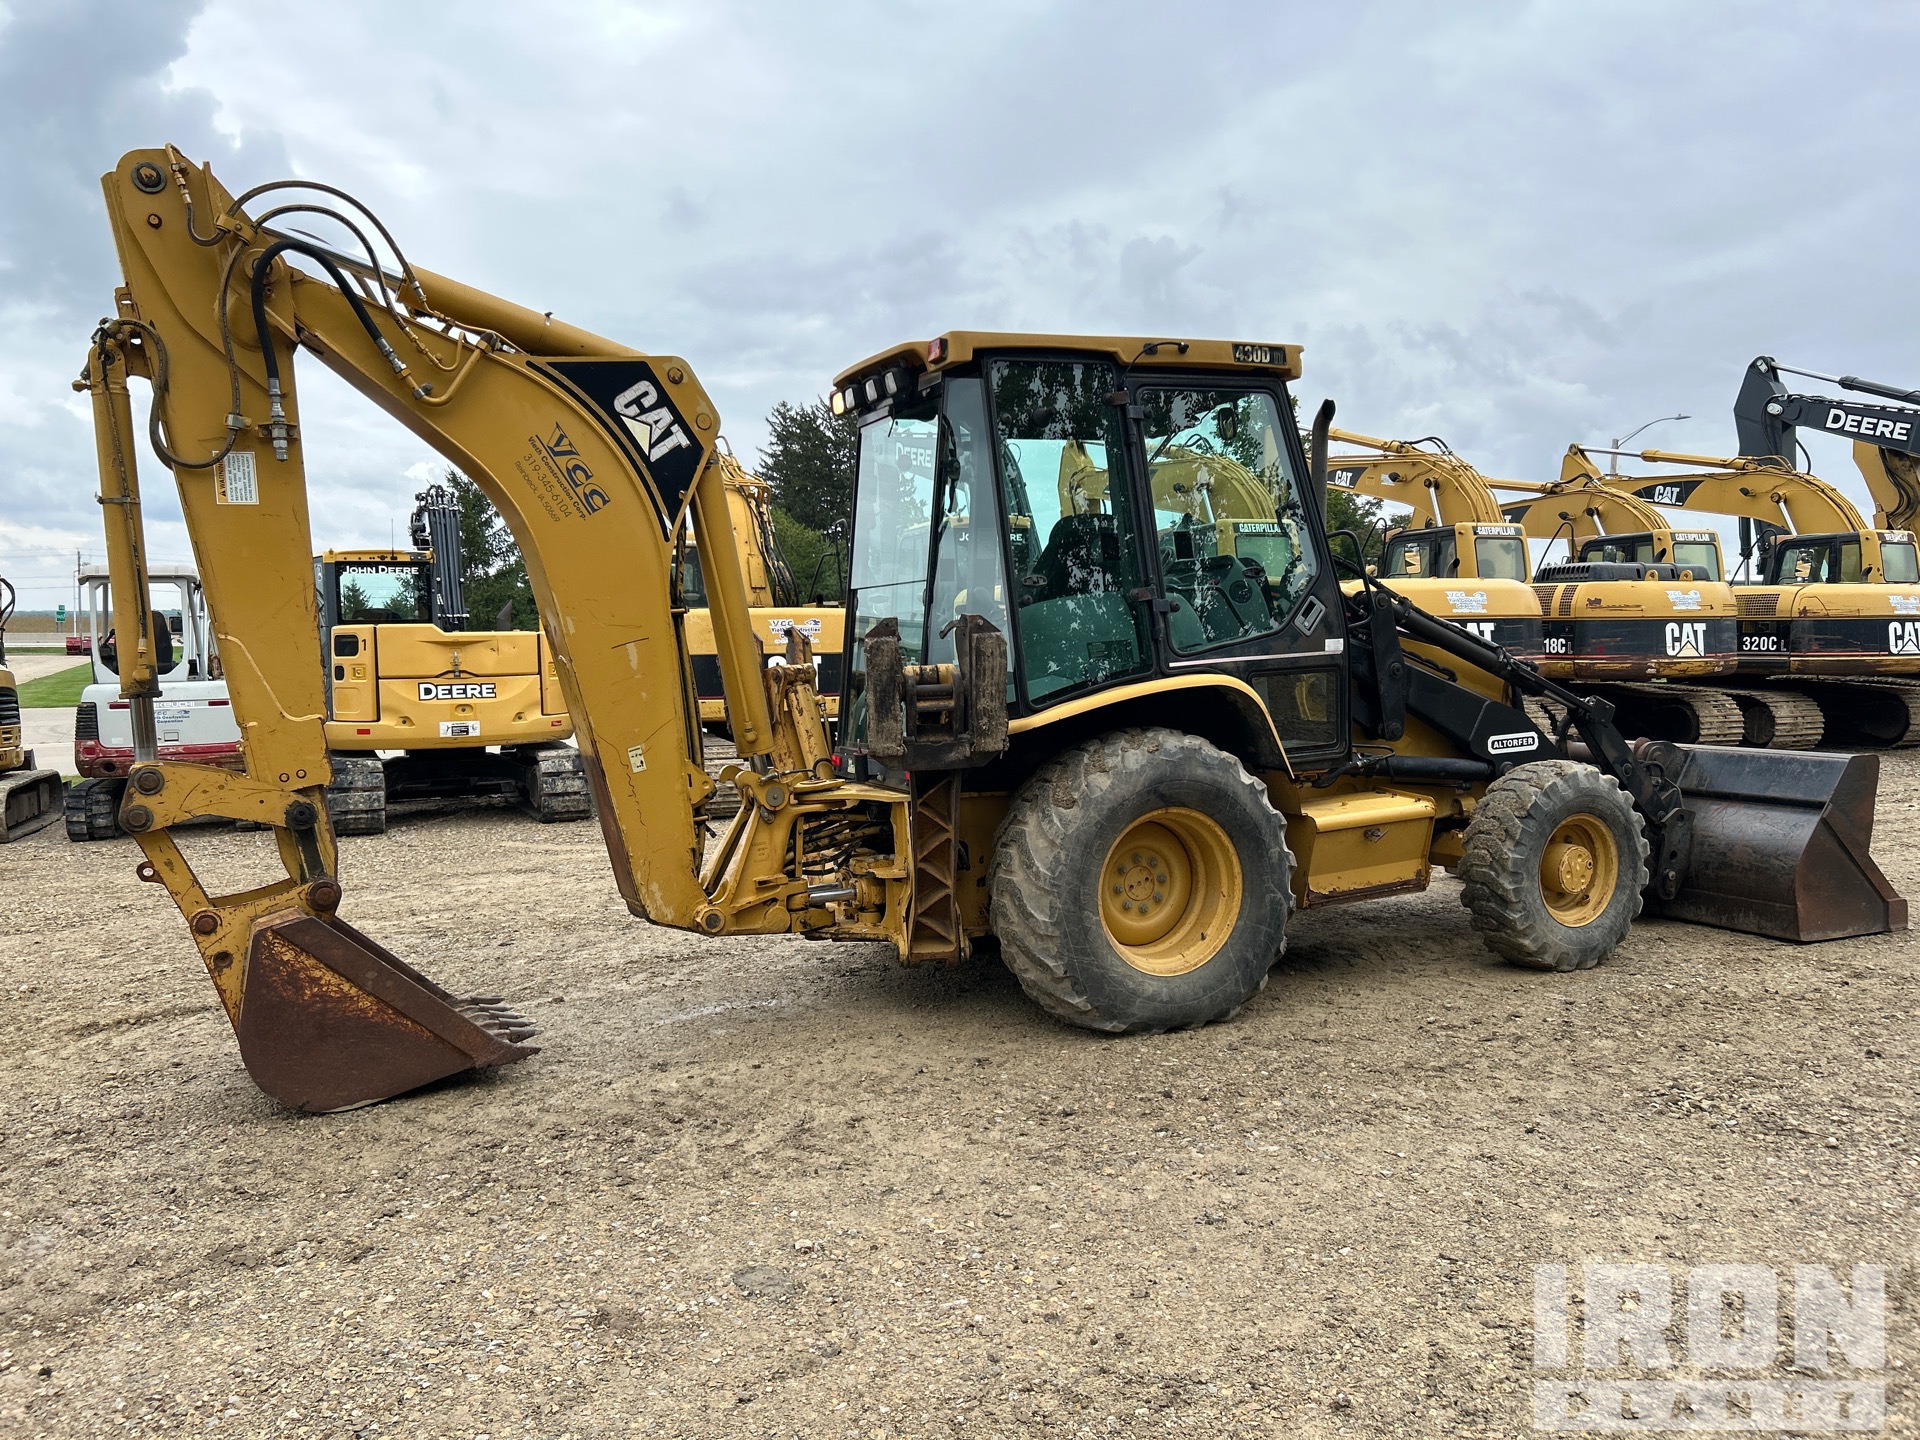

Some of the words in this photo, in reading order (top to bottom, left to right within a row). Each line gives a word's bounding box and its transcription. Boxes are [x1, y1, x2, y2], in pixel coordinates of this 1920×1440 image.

[1236, 346, 1270, 363] 430D
[613, 380, 690, 462] CAT
[1826, 408, 1911, 441] DEERE
[546, 422, 611, 513] VCC
[523, 453, 572, 518] 319-345-6104
[527, 436, 544, 456] Vieth
[540, 455, 575, 501] Construction
[571, 500, 589, 522] Corp.
[1335, 470, 1352, 487] CAT
[1654, 486, 1680, 504] CAT
[542, 501, 561, 523] 50669
[1239, 523, 1281, 532] CATERPILLA
[1477, 526, 1515, 536] CATERPILLAR
[1675, 533, 1710, 541] CATERPILLAR
[343, 566, 375, 574] JOHN
[378, 566, 419, 574] DEERE
[1450, 622, 1494, 641] AT
[1666, 622, 1706, 656] CAT
[1544, 638, 1565, 653] 18C
[1743, 637, 1777, 650] 320C
[1781, 640, 1786, 651] L
[419, 683, 496, 700] DEERE
[1493, 738, 1533, 748] ALTORFER
